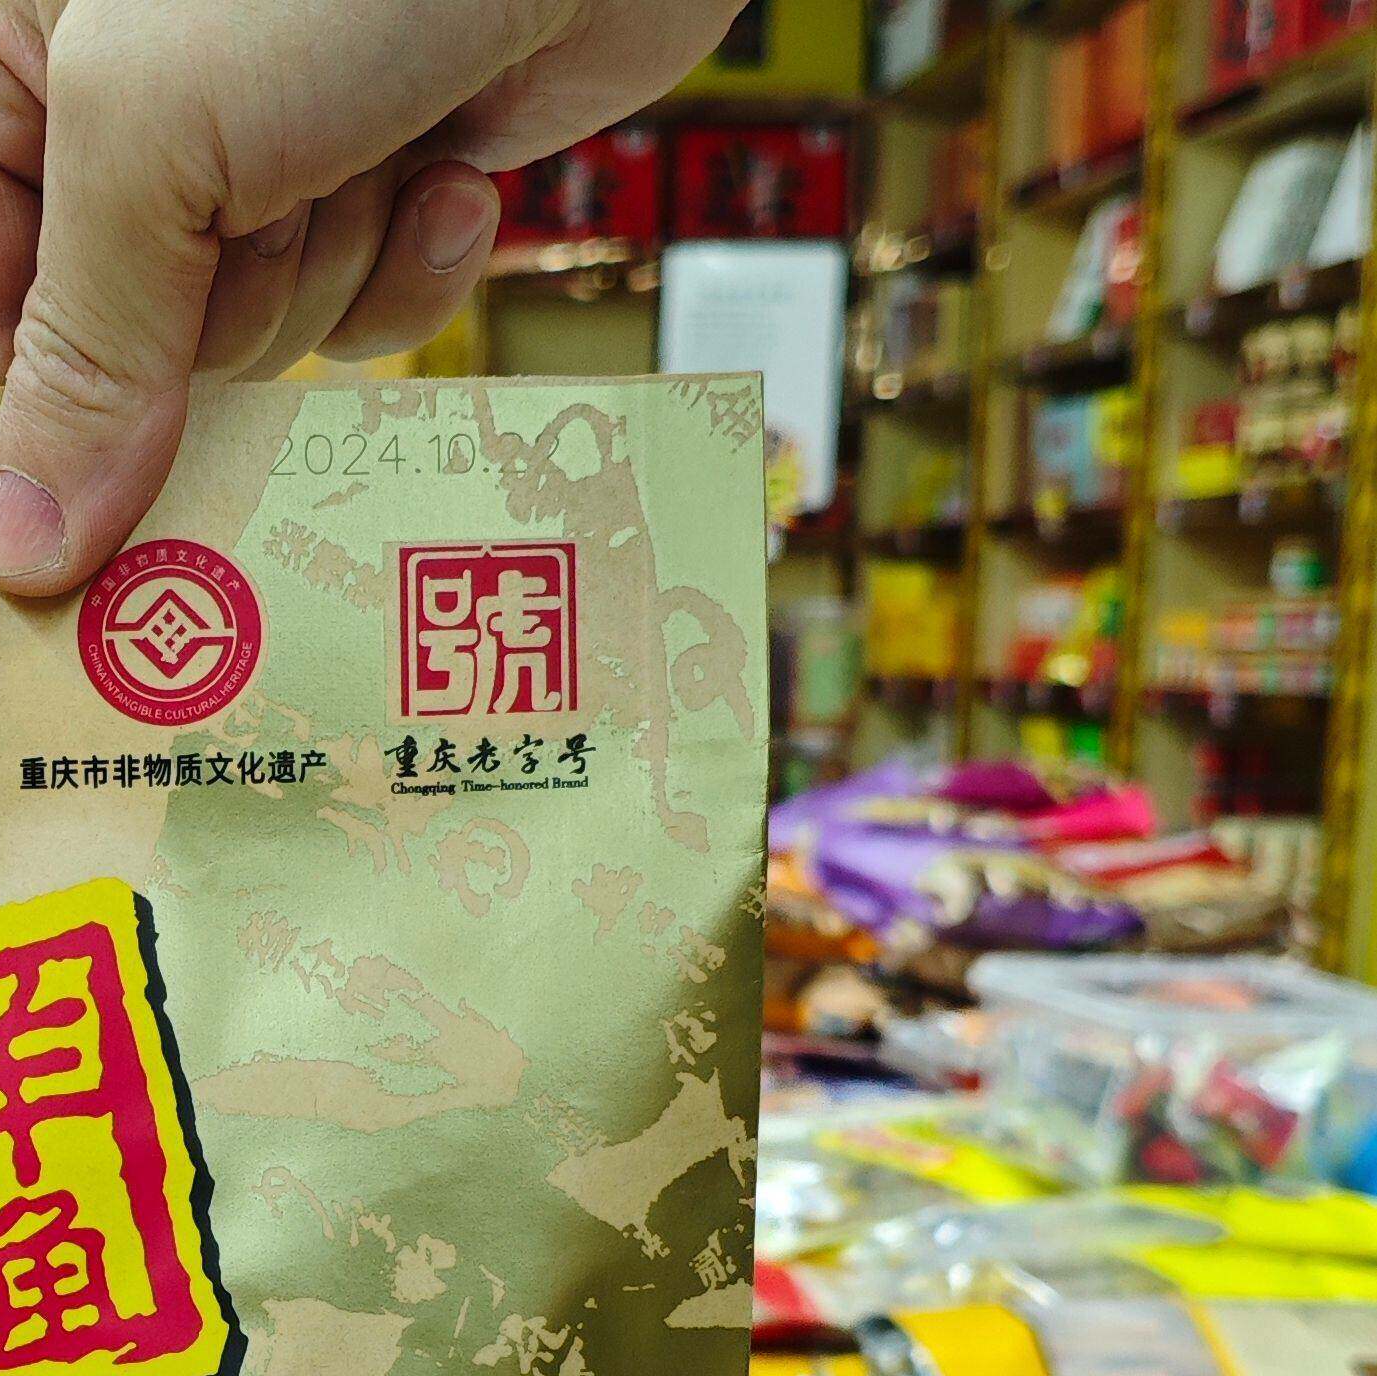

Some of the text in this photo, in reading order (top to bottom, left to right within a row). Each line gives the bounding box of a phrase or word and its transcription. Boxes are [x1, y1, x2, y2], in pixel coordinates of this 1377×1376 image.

[88, 641, 254, 721] CHINA INTANGIBLE CULTURAL HERITAGE
[20, 752, 329, 791] 重庆市非物质文化遗产
[383, 733, 597, 779] 重庆老字号
[390, 781, 457, 797] Chongqing
[551, 775, 590, 790] Brand
